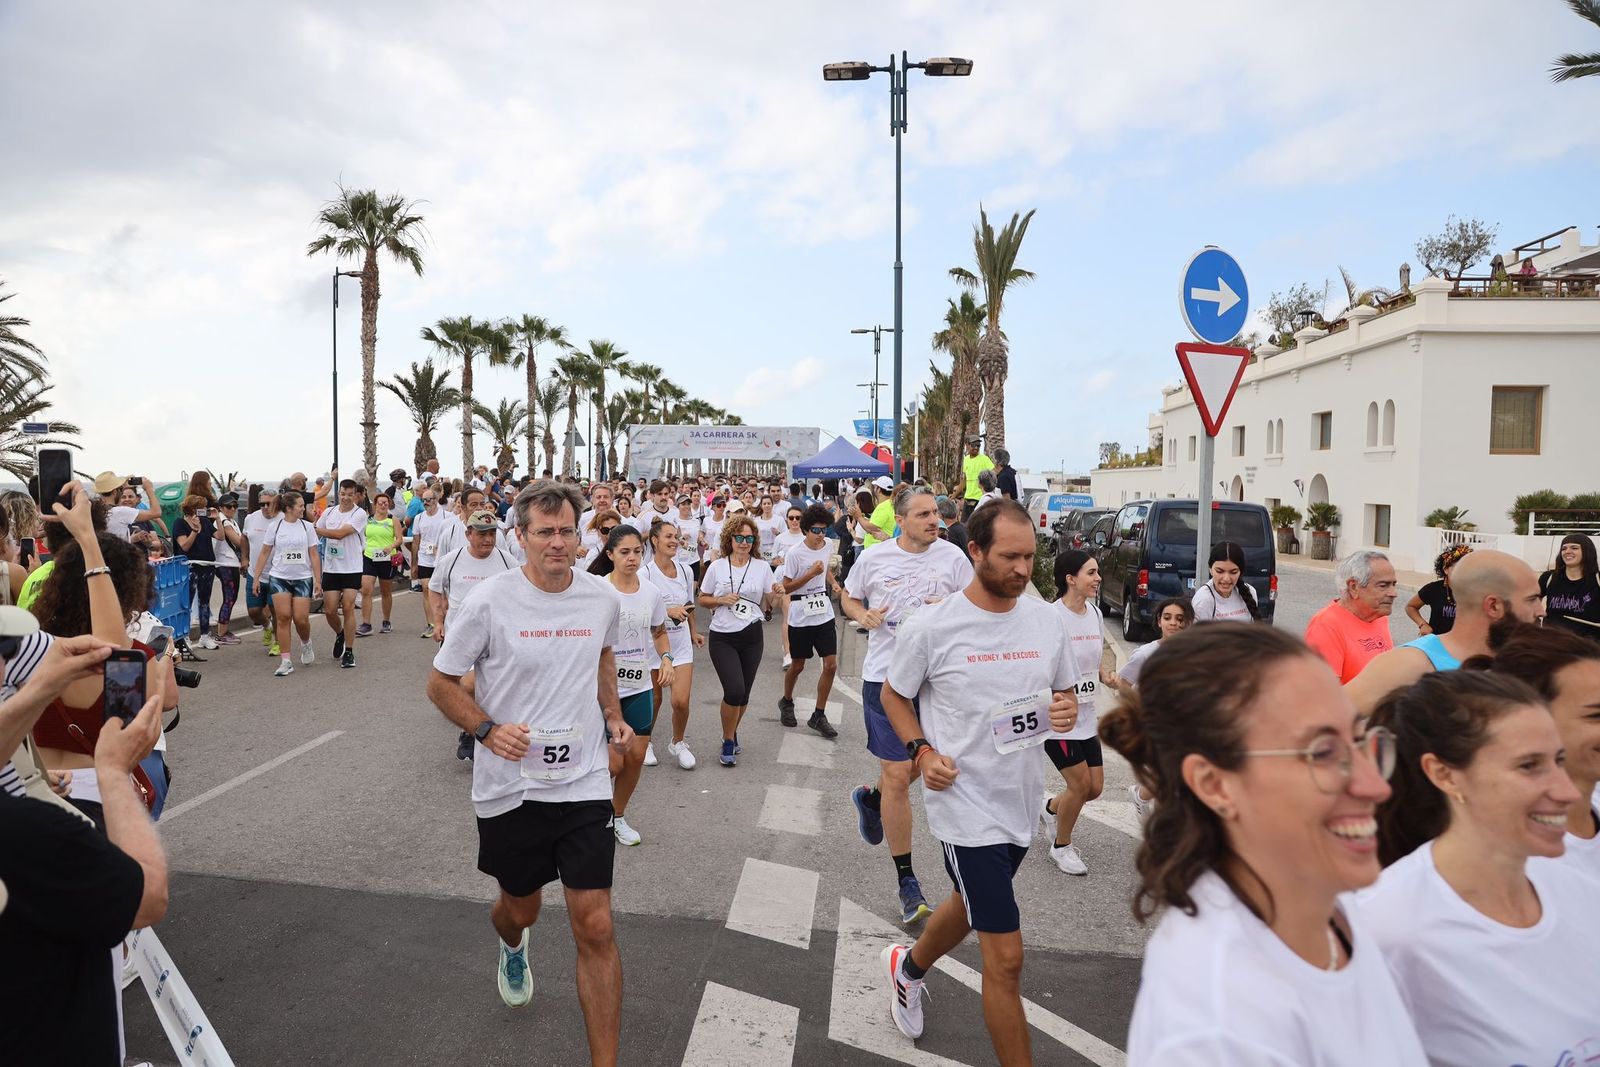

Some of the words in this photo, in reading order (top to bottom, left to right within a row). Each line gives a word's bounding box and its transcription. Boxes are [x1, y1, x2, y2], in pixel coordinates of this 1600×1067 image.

[702, 431, 744, 439] CARRERA
[286, 552, 302, 560] 238
[735, 603, 747, 614] 12
[808, 600, 825, 609] 718
[520, 630, 529, 638] NO
[967, 655, 977, 663] NO
[1002, 652, 1012, 660] NO
[617, 668, 643, 680] 868
[1073, 681, 1095, 695] 149
[1011, 711, 1039, 734] 55
[542, 744, 570, 764] 52
